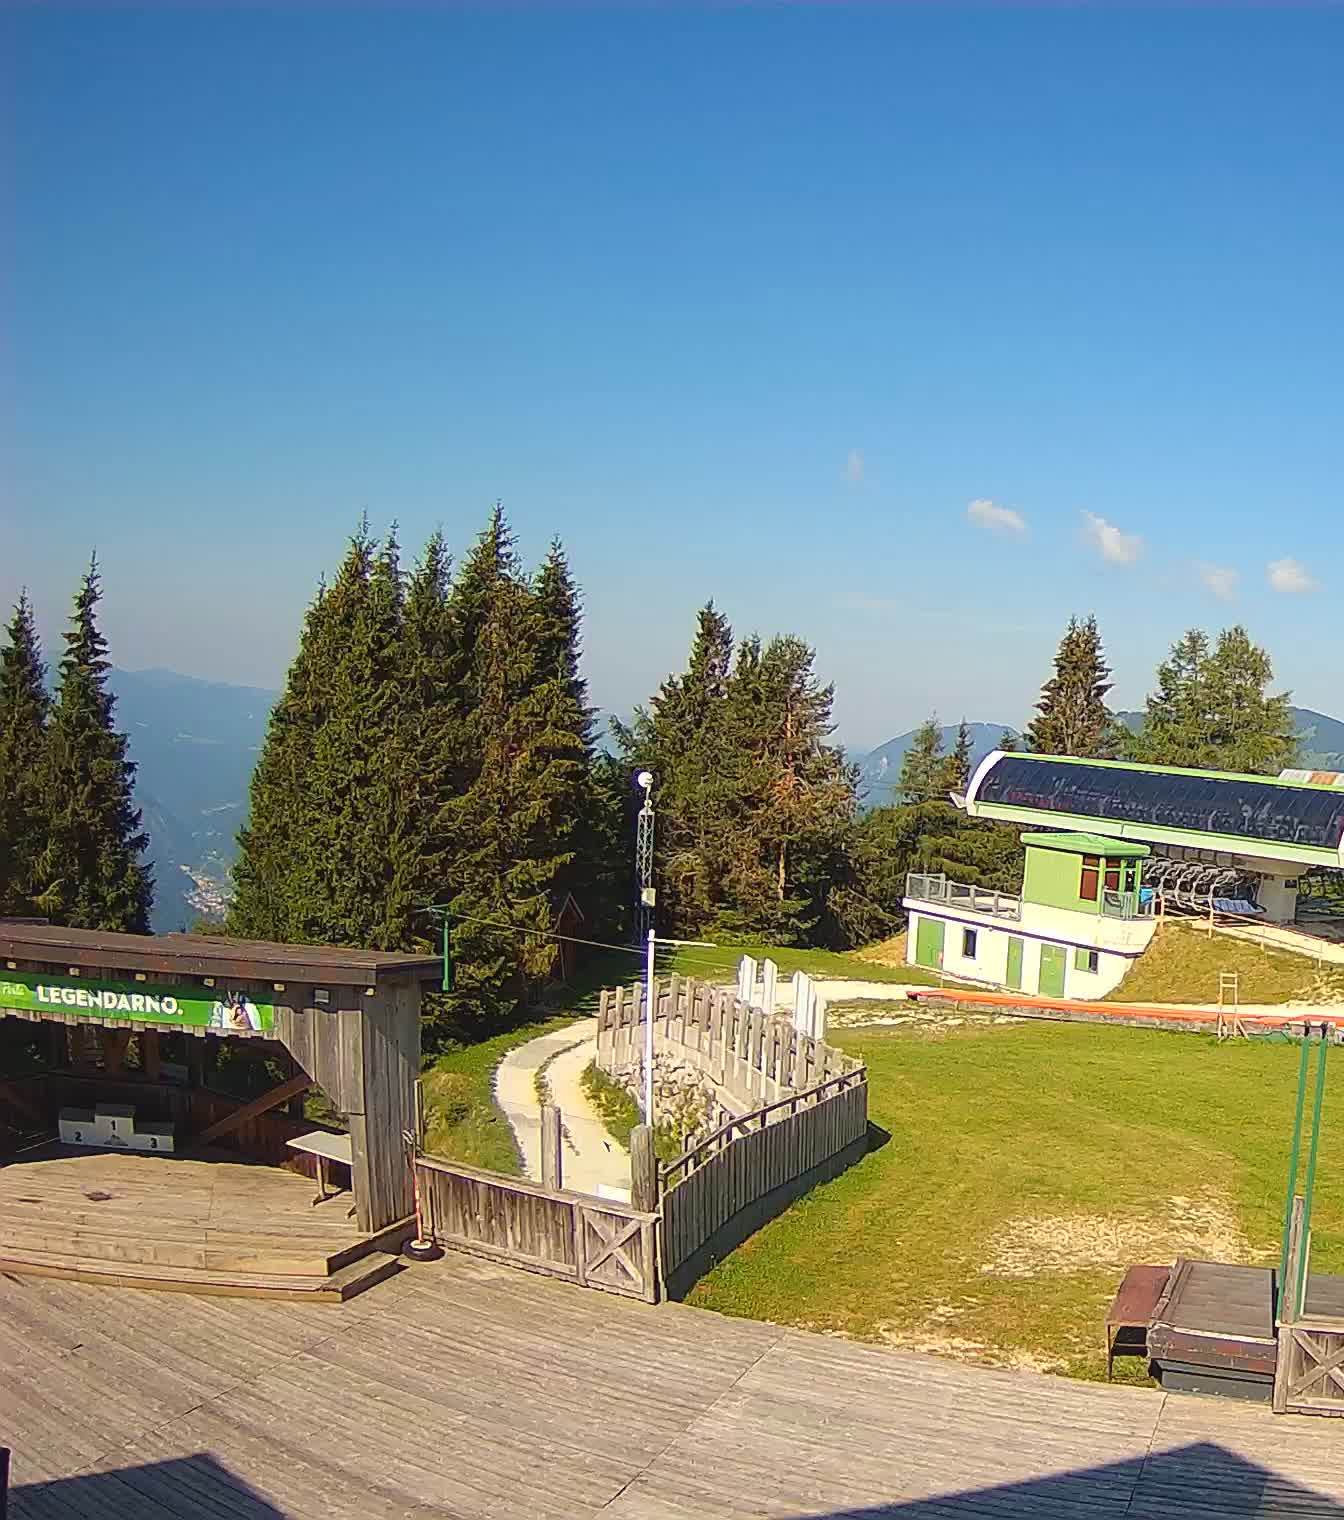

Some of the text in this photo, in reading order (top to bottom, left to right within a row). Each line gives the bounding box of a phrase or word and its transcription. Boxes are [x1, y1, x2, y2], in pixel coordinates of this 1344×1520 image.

[37, 985, 184, 1016] LEGENDARNO.
[110, 1119, 117, 1131] 1
[74, 1131, 83, 1142] 2
[150, 1137, 158, 1149] 3
